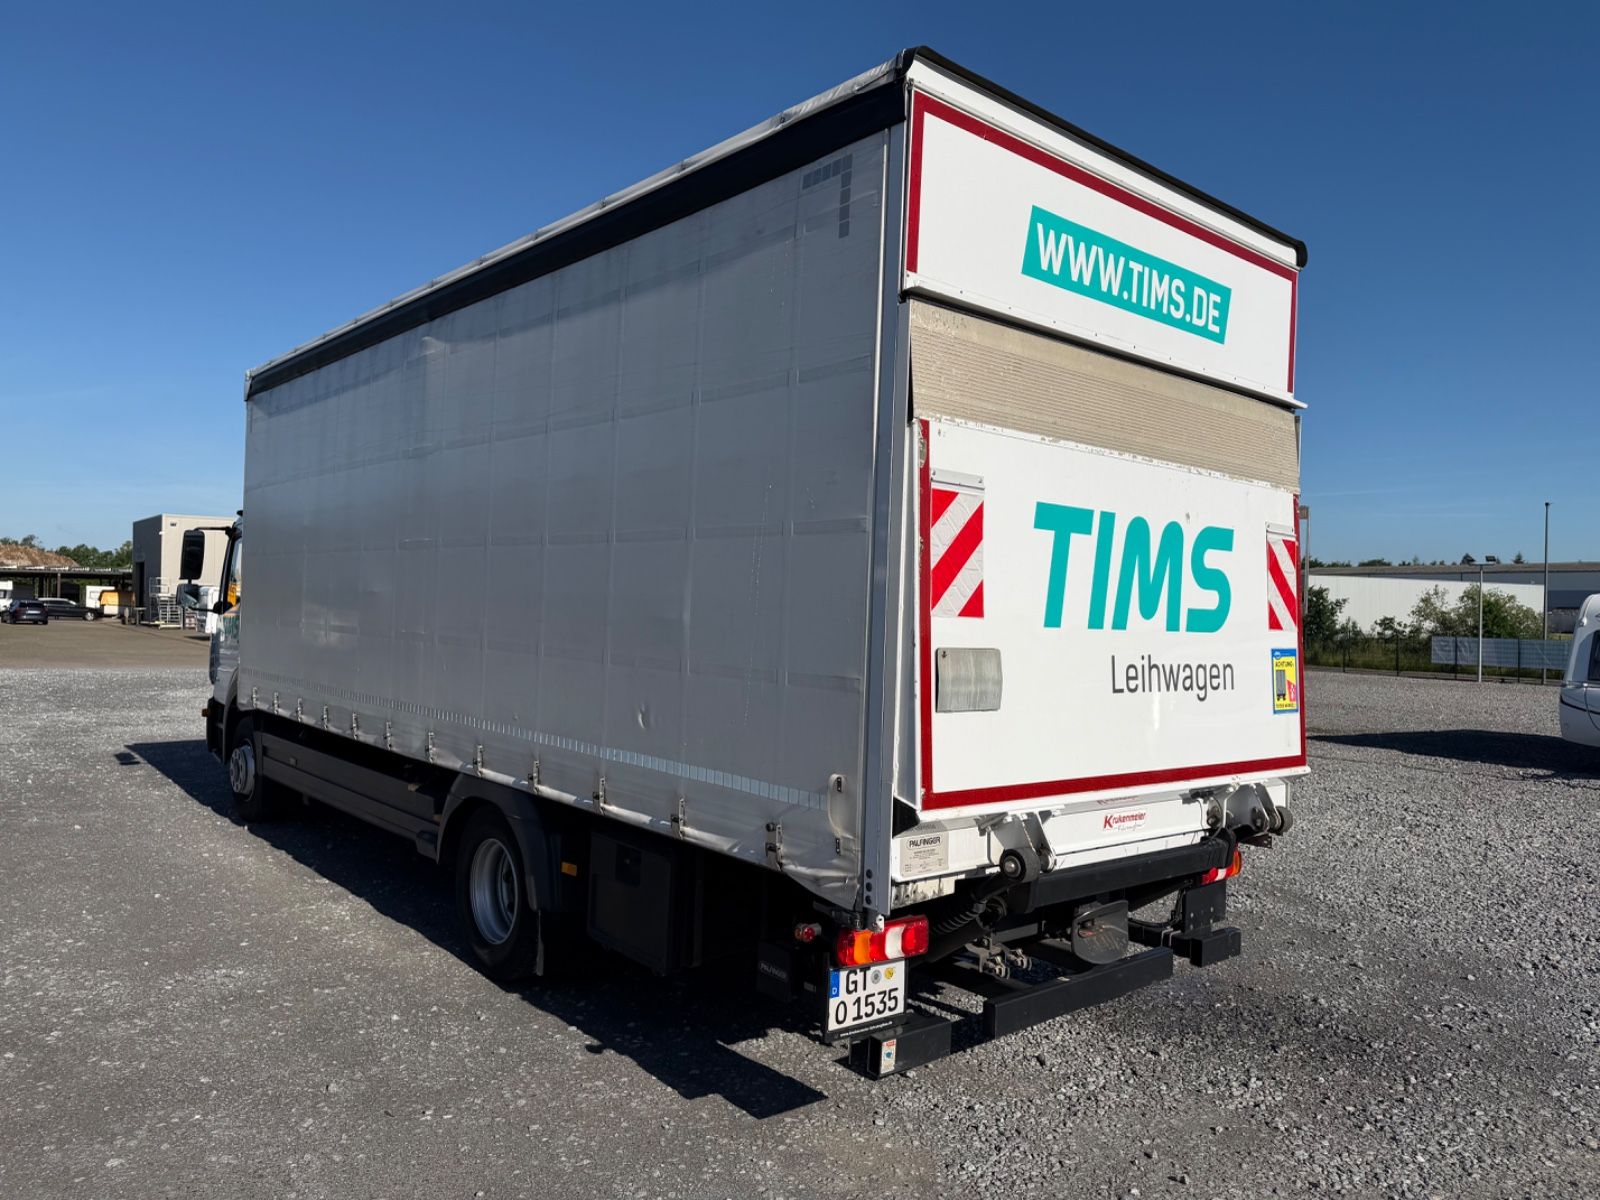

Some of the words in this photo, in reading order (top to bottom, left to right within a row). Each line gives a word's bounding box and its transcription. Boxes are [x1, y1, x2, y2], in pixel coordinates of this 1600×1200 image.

[1036, 222, 1222, 334] WWW.TIMS.DE
[1033, 501, 1235, 634] TIMS
[1111, 654, 1235, 702] Leihwagen
[908, 836, 941, 848] PALFINGER
[846, 967, 871, 994] GT
[852, 987, 899, 1022] 1535
